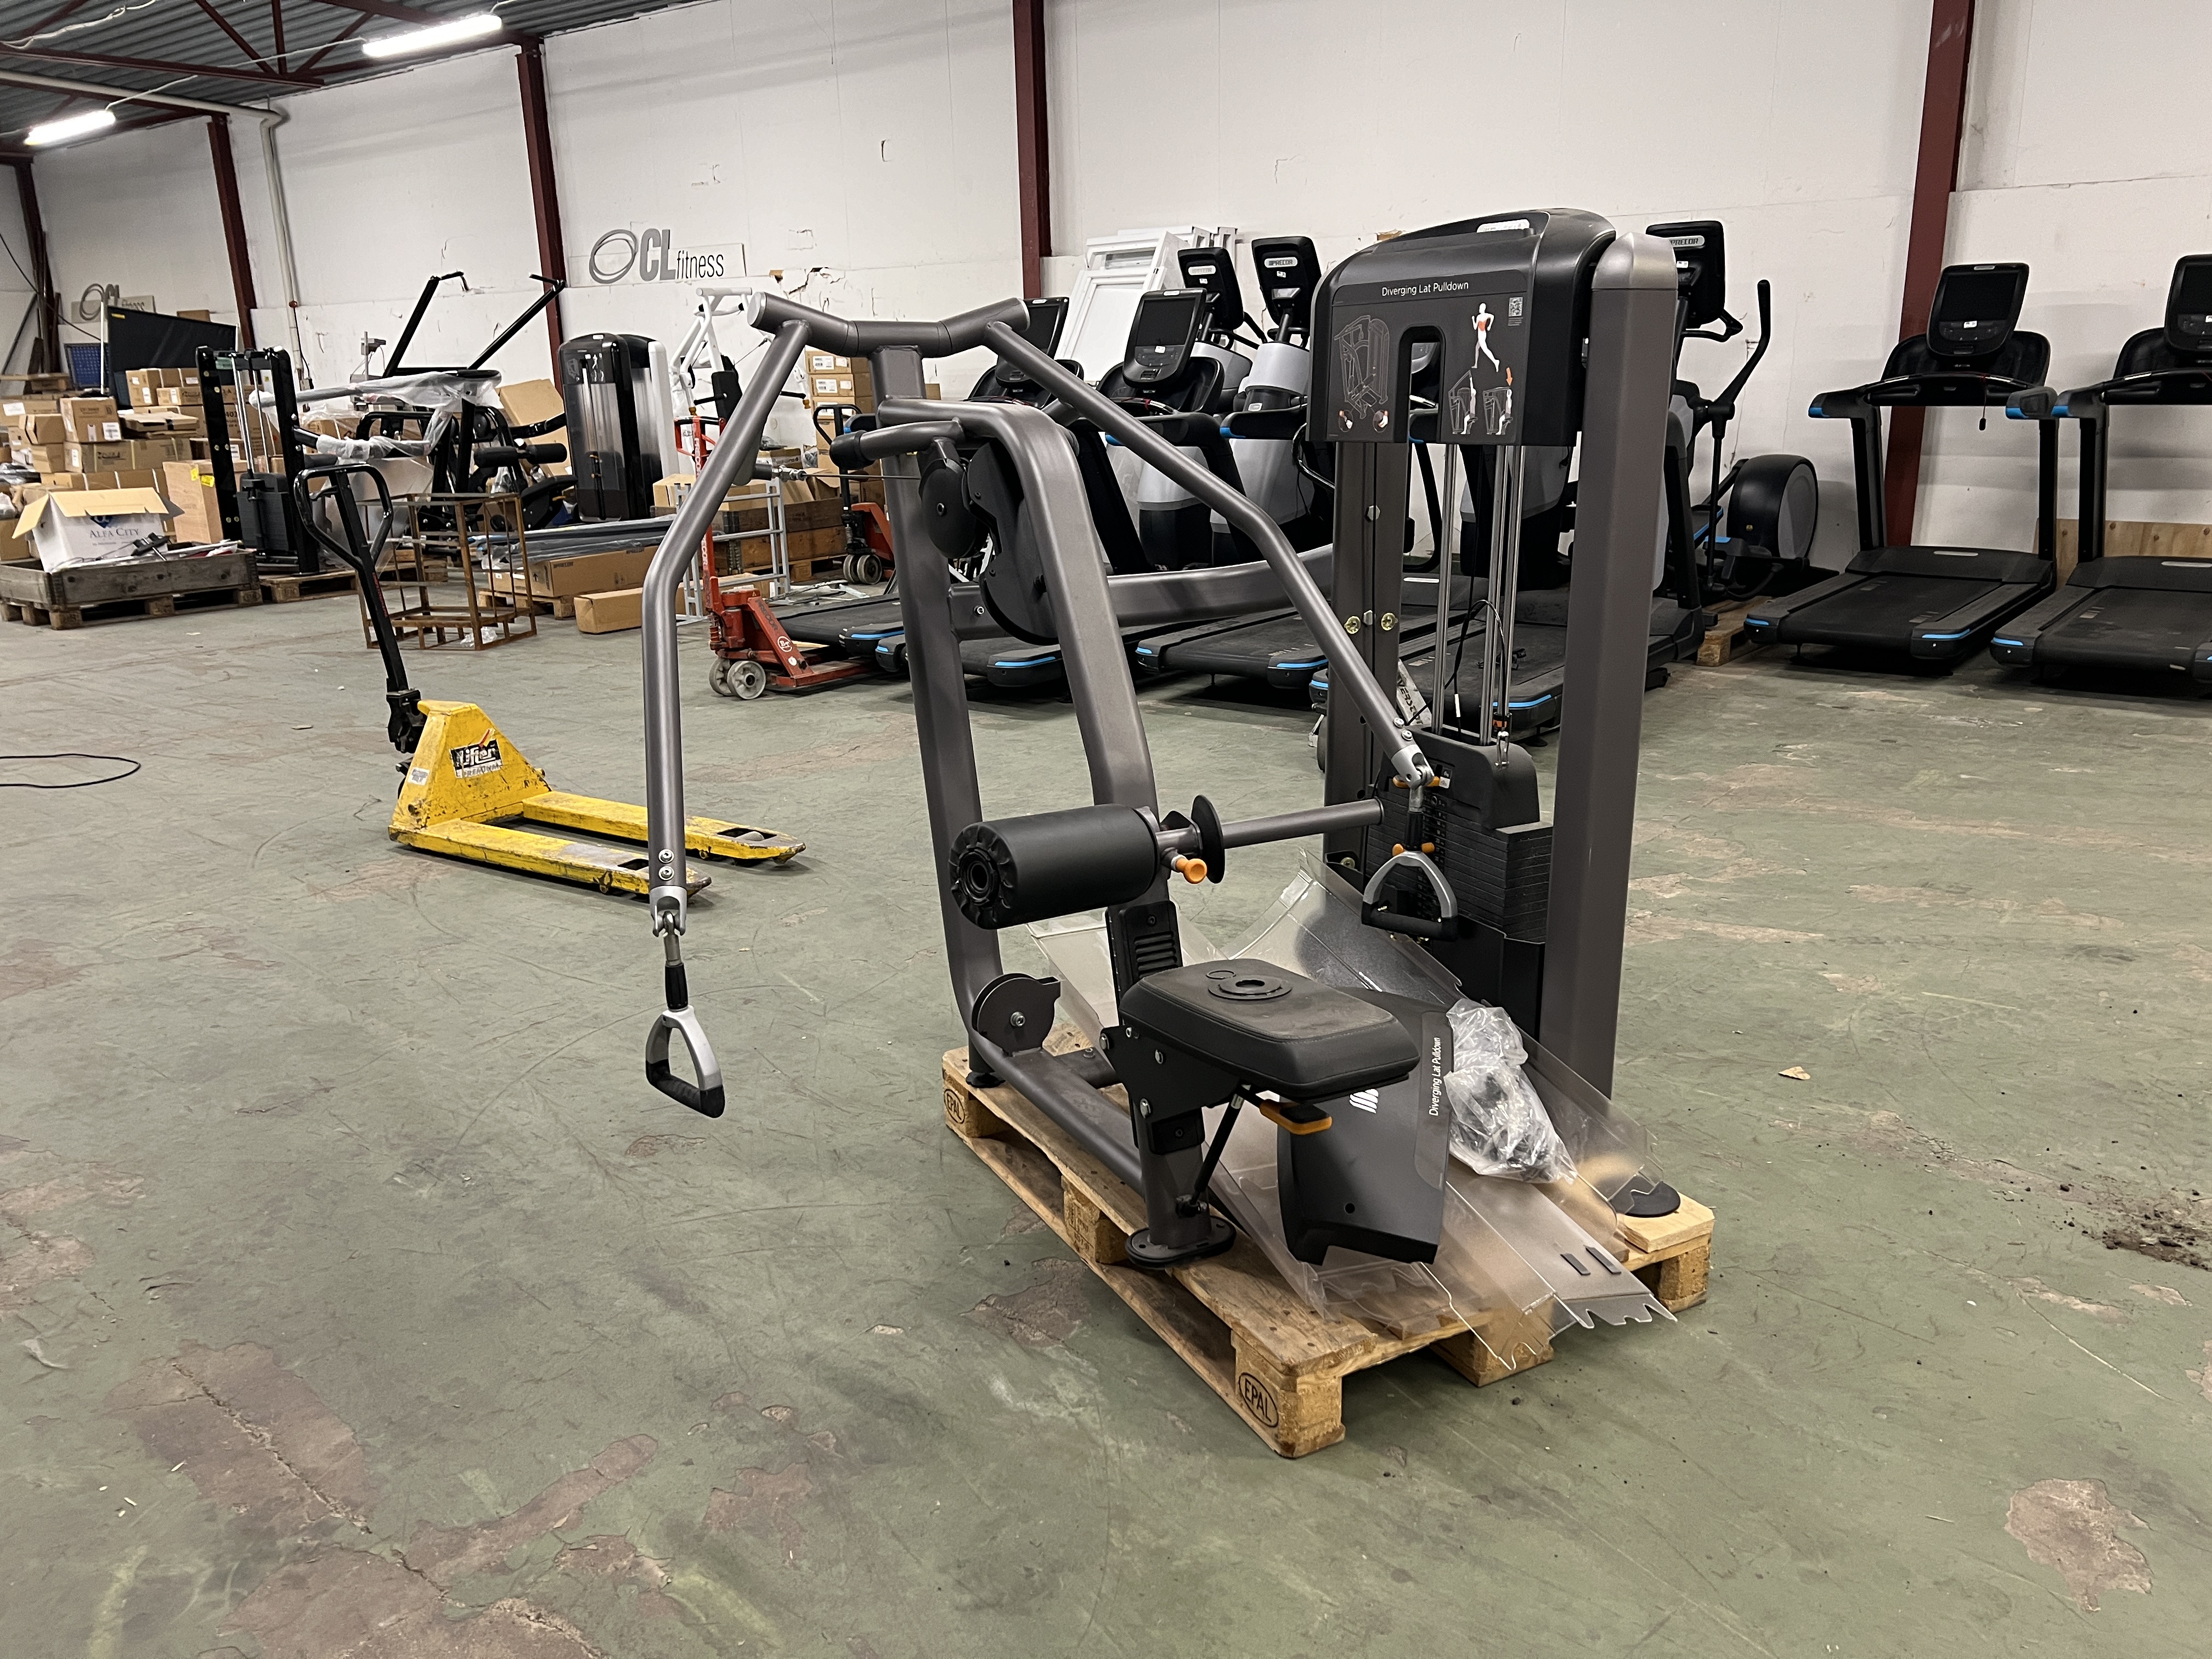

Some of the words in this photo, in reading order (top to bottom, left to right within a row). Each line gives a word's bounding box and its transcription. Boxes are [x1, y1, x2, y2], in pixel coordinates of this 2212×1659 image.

[676, 250, 724, 279] fitness
[1382, 285, 1417, 297] Diverging
[1419, 284, 1431, 294] Lat
[1433, 281, 1469, 292] Pulldown
[1431, 1036, 1442, 1065] Pulldown
[1431, 1064, 1441, 1077] Lat
[1429, 1077, 1442, 1116] Diverging
[1244, 1378, 1272, 1423] EPAL
